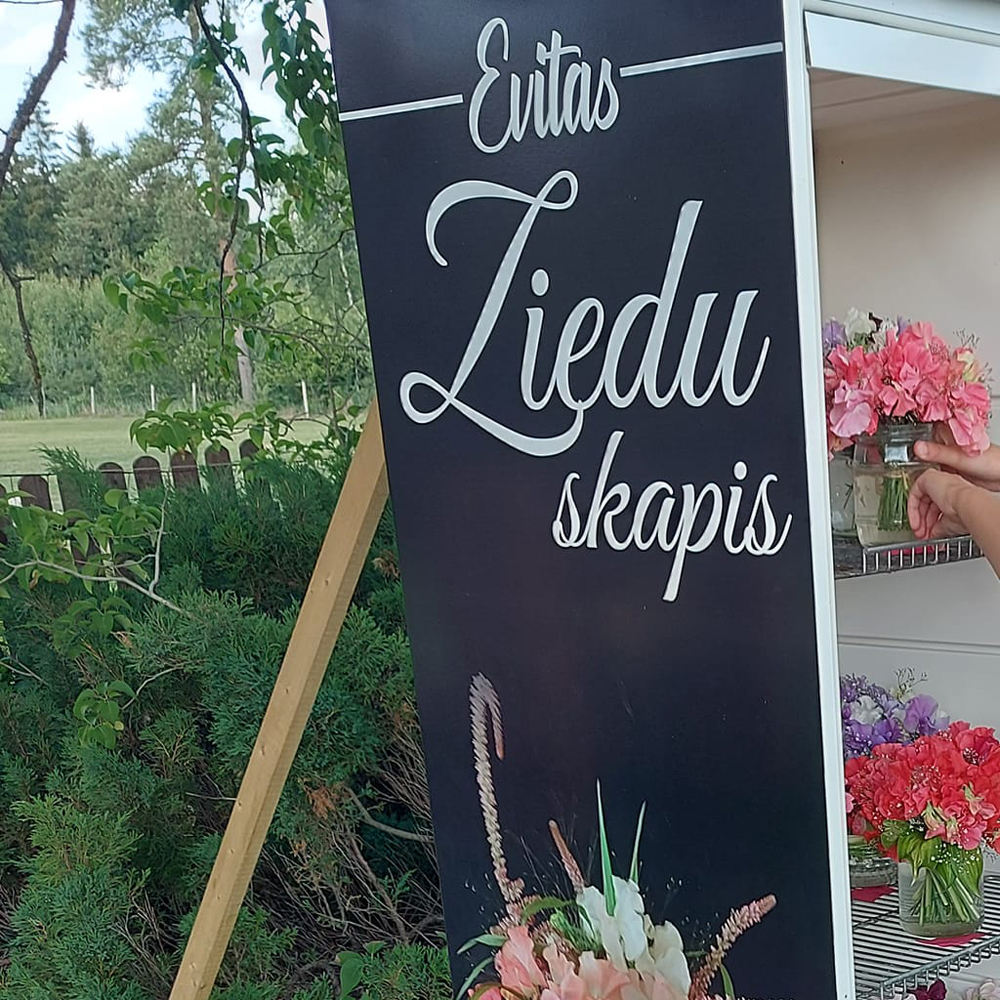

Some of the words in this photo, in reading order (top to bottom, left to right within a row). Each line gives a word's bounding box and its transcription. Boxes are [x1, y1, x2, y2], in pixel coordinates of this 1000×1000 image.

[468, 17, 620, 153] Evitas
[400, 170, 770, 457] Ziedu
[552, 430, 792, 601] skapis
